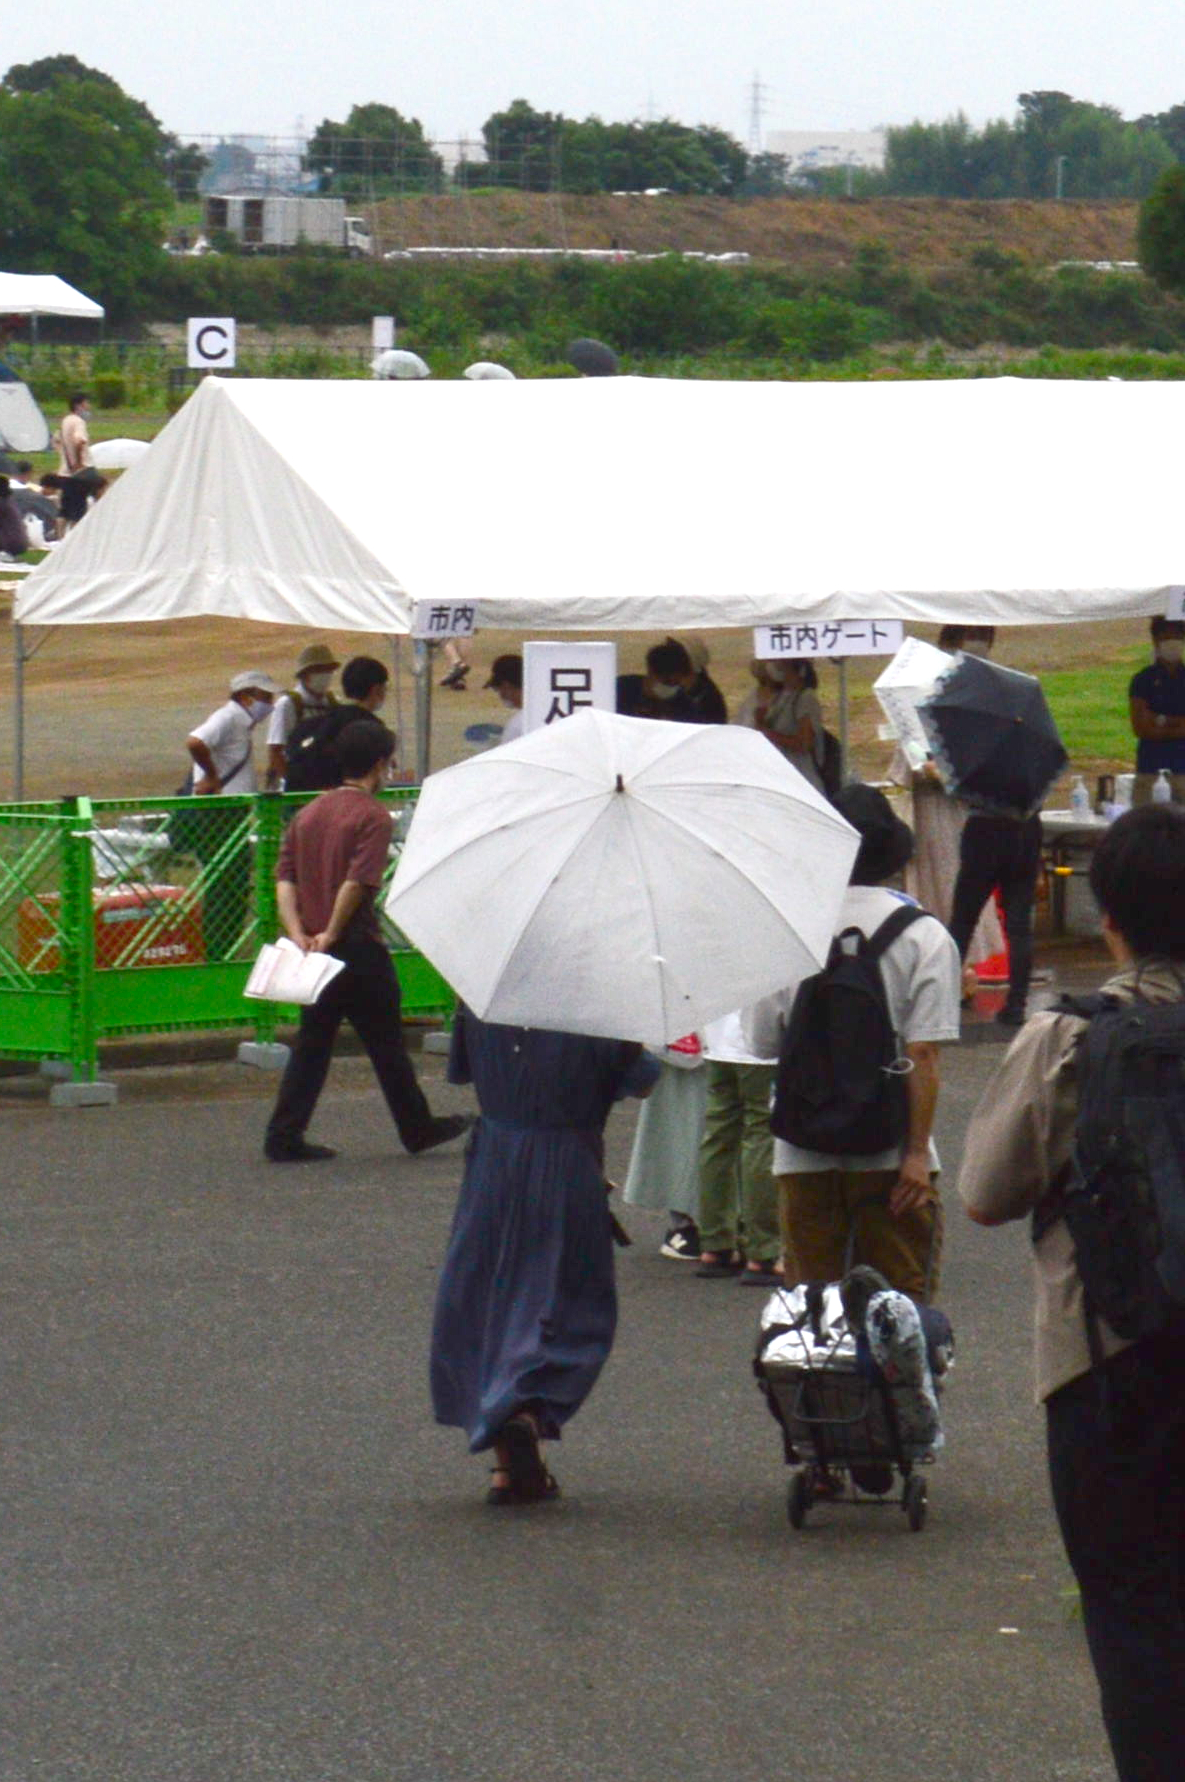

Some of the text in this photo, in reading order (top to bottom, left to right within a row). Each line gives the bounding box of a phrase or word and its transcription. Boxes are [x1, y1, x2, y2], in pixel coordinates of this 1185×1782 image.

[196, 325, 228, 360] C
[428, 604, 474, 631] 市内
[769, 623, 888, 652] 市内ゲート
